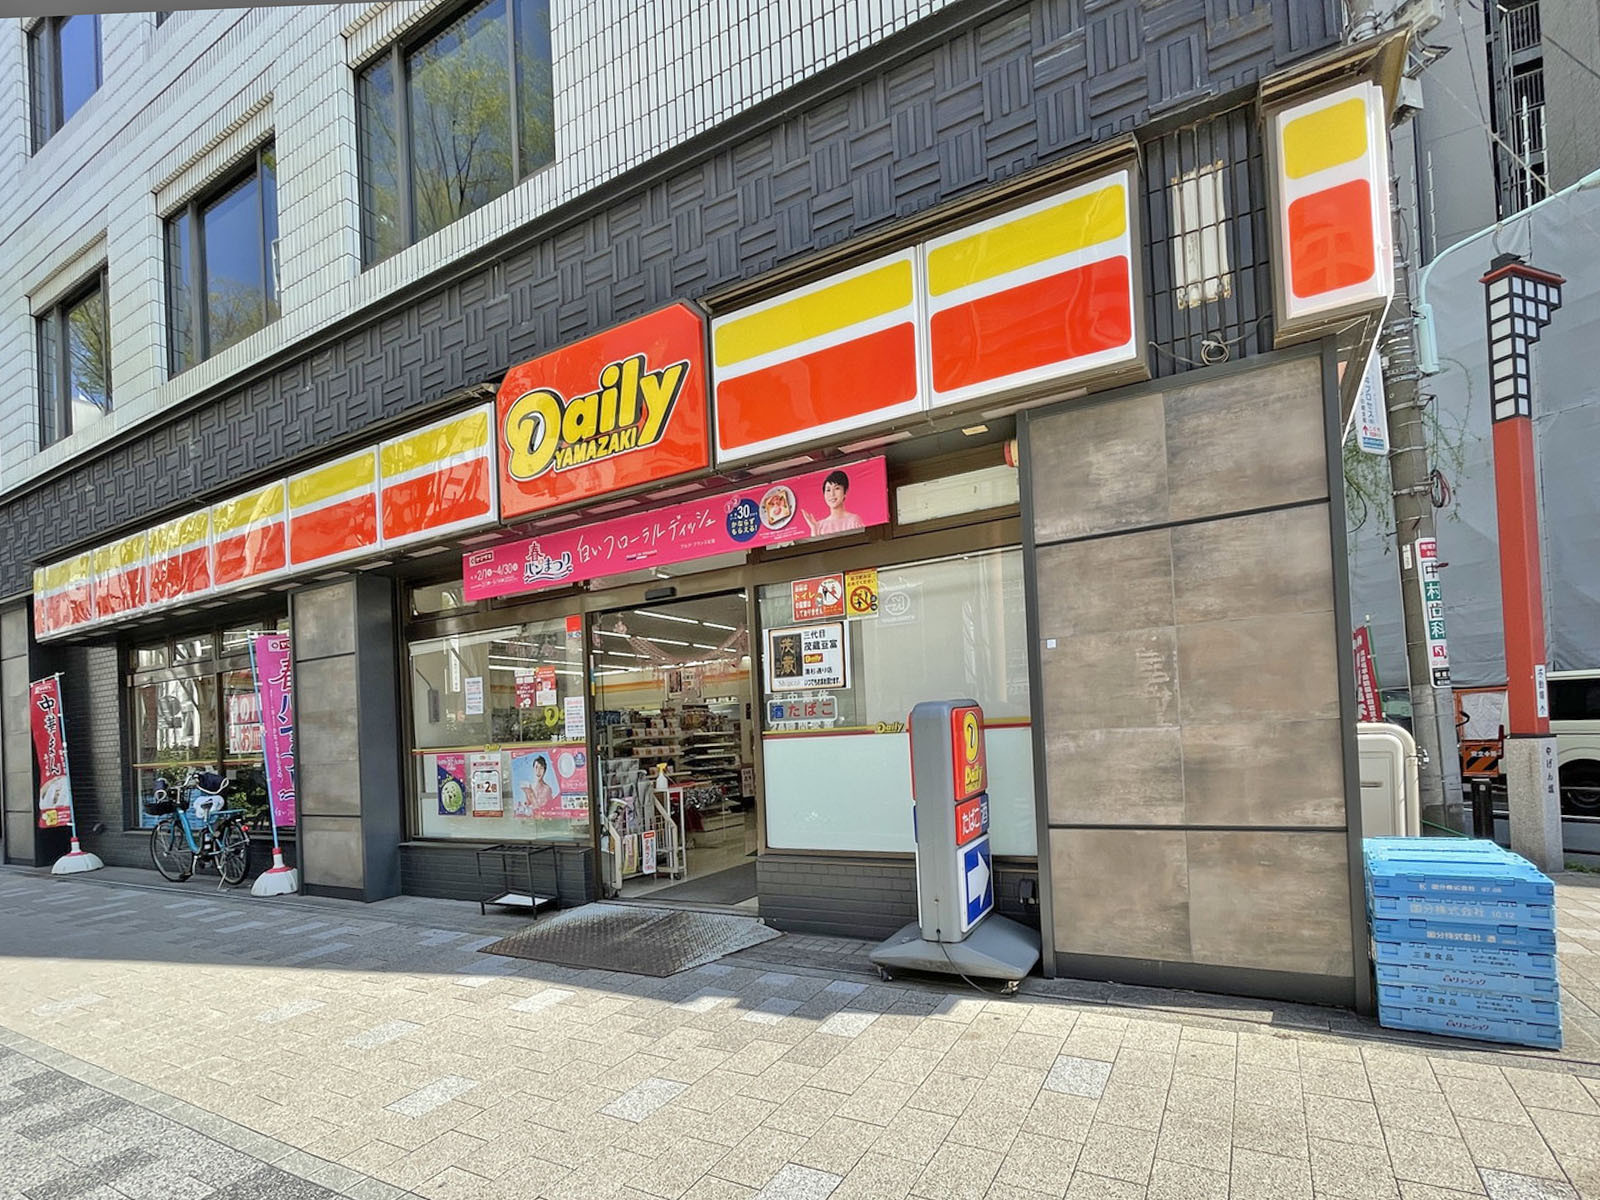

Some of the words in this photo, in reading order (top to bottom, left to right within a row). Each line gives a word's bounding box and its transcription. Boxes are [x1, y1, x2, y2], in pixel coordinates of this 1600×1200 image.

[505, 353, 690, 481] Daily
[555, 426, 638, 471] YAMAZAKI
[577, 509, 716, 563] 白いフローラルディッシュ
[1423, 561, 1446, 640] 中村歯科
[803, 629, 826, 640] 三代目
[772, 704, 785, 719] 酒
[788, 702, 834, 718] たばこ
[875, 721, 905, 734] Daily
[962, 806, 980, 836] たばこ
